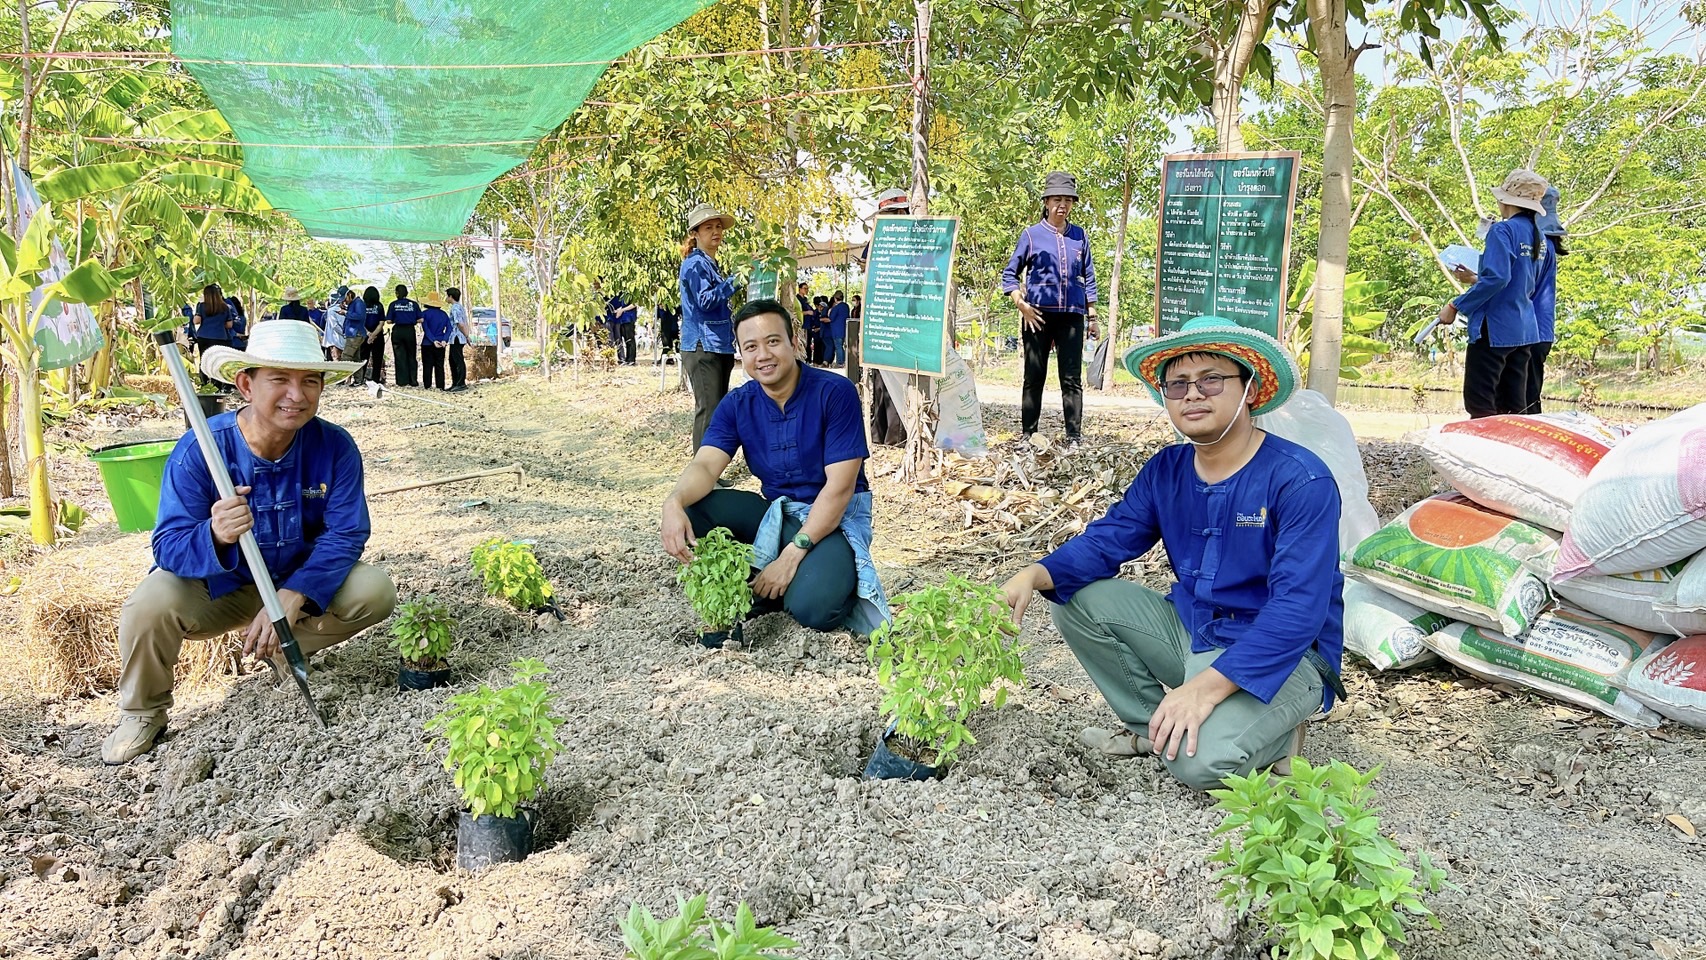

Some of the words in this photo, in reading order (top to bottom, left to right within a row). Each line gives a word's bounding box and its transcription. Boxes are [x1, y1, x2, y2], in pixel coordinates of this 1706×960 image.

[1176, 168, 1214, 178] ฮอร์โมนไส้กล้วย
[1233, 167, 1275, 177] ฮอร์โมนหัวปลี
[1239, 182, 1266, 194] บำรุงดอก
[1495, 657, 1520, 671] บรรจุ
[1541, 671, 1577, 687] กิโลกรัม
